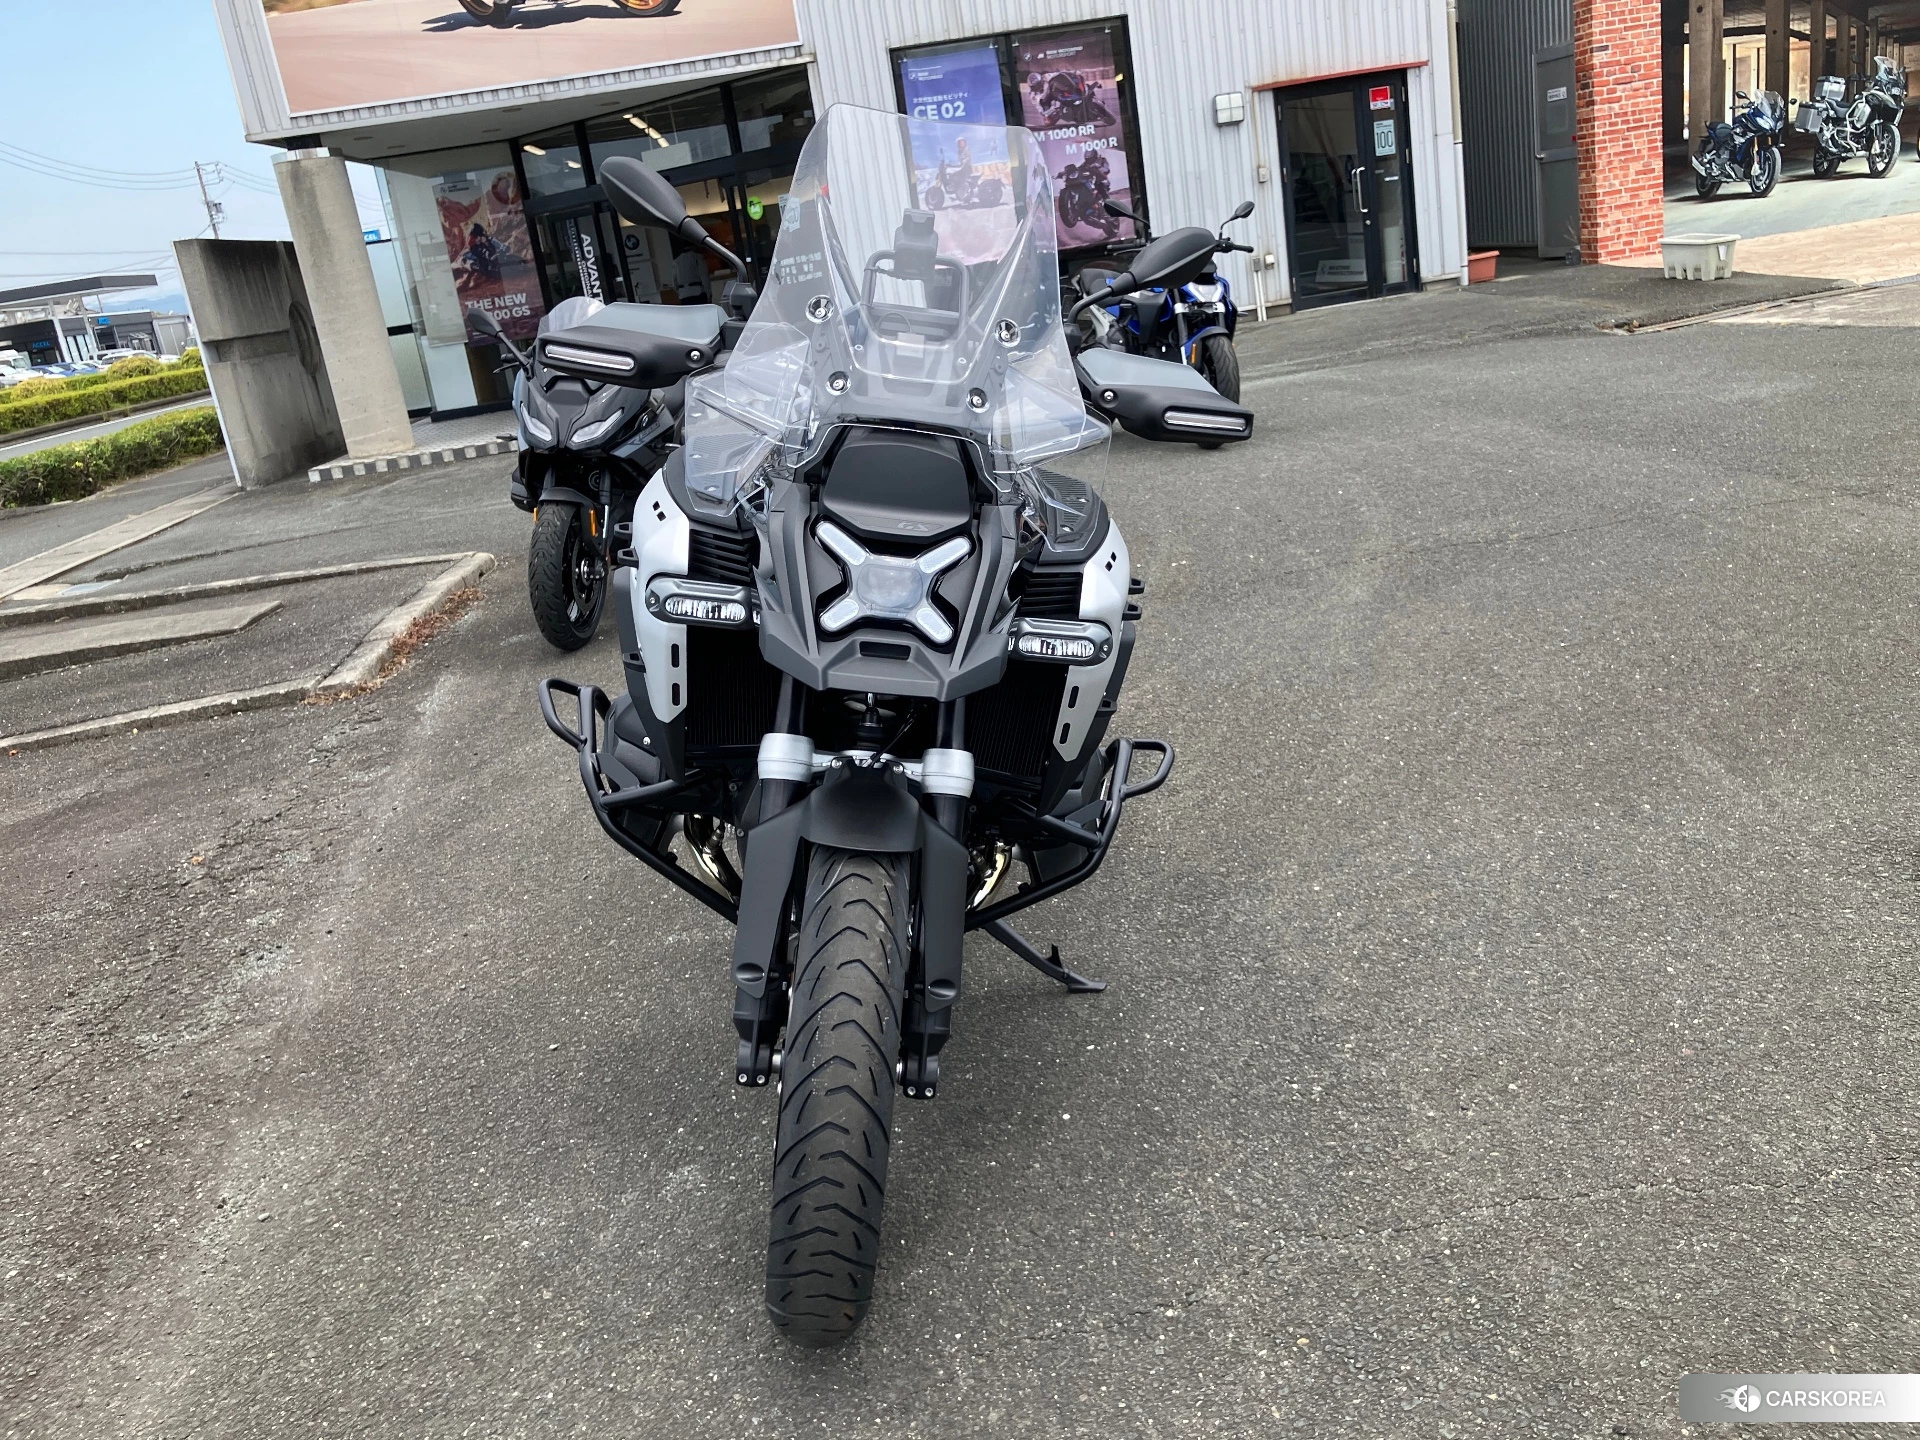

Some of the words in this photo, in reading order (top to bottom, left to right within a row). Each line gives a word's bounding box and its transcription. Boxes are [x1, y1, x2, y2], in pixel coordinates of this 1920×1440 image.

[913, 104, 939, 120] CE
[941, 101, 966, 118] 02
[1048, 127, 1077, 141] 1000
[1079, 124, 1096, 136] RR
[1376, 130, 1394, 149] 100
[1065, 144, 1078, 155] M
[1080, 139, 1107, 152] 1000
[1109, 137, 1118, 147] R
[465, 298, 493, 310] THE
[494, 292, 527, 307] NEW
[511, 306, 531, 317] GS
[897, 521, 929, 532] GS
